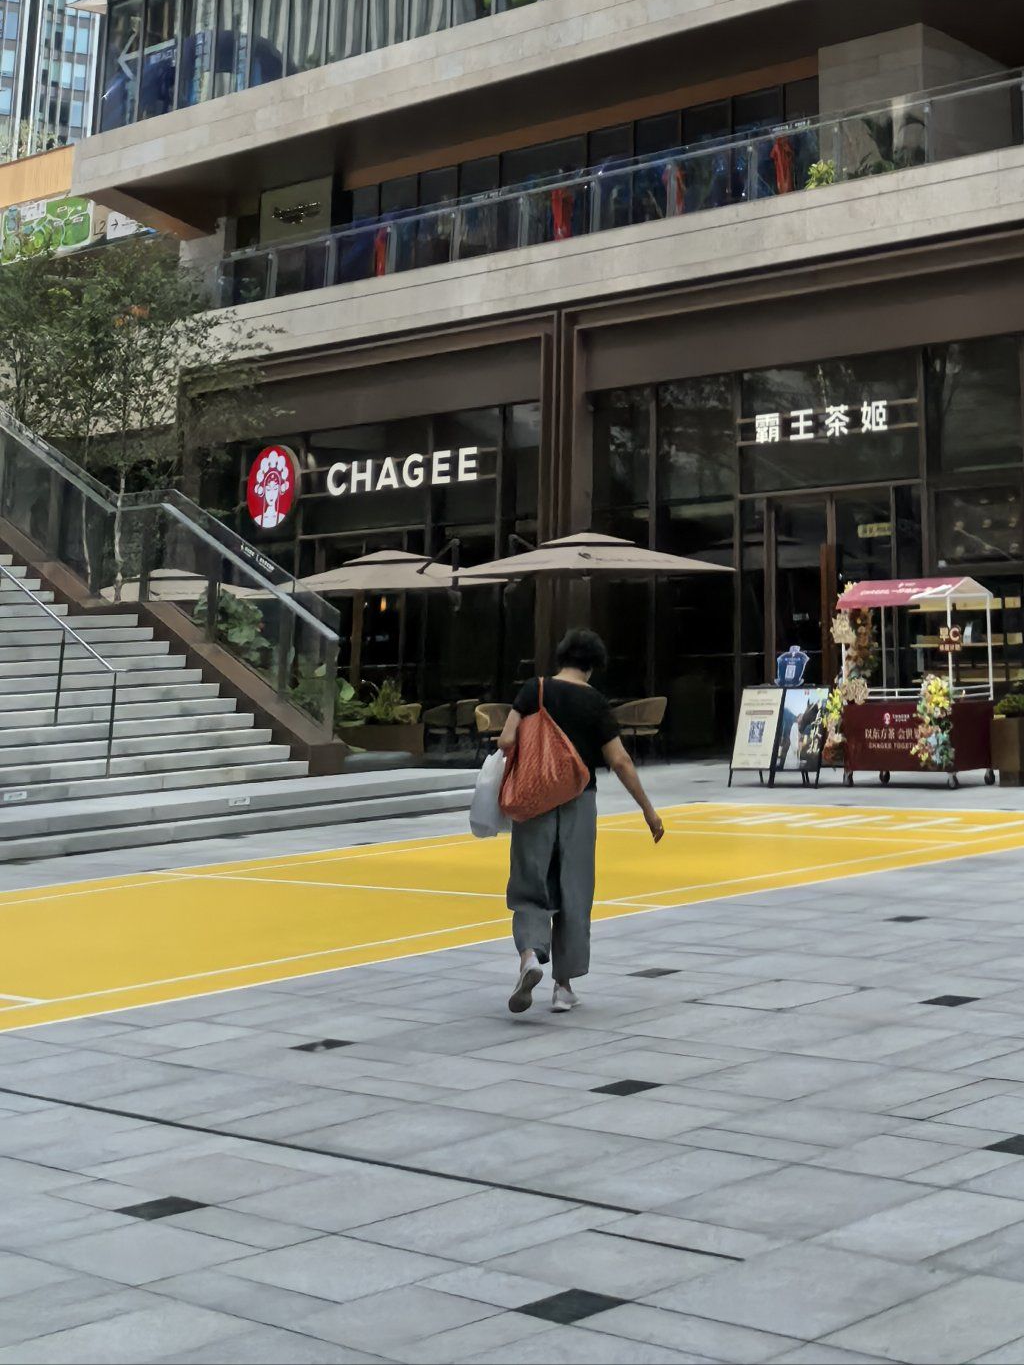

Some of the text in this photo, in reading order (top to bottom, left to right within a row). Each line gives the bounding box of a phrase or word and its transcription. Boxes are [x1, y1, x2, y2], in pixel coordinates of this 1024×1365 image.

[755, 400, 888, 443] 霸王茶姬
[327, 446, 478, 496] CHAGEE
